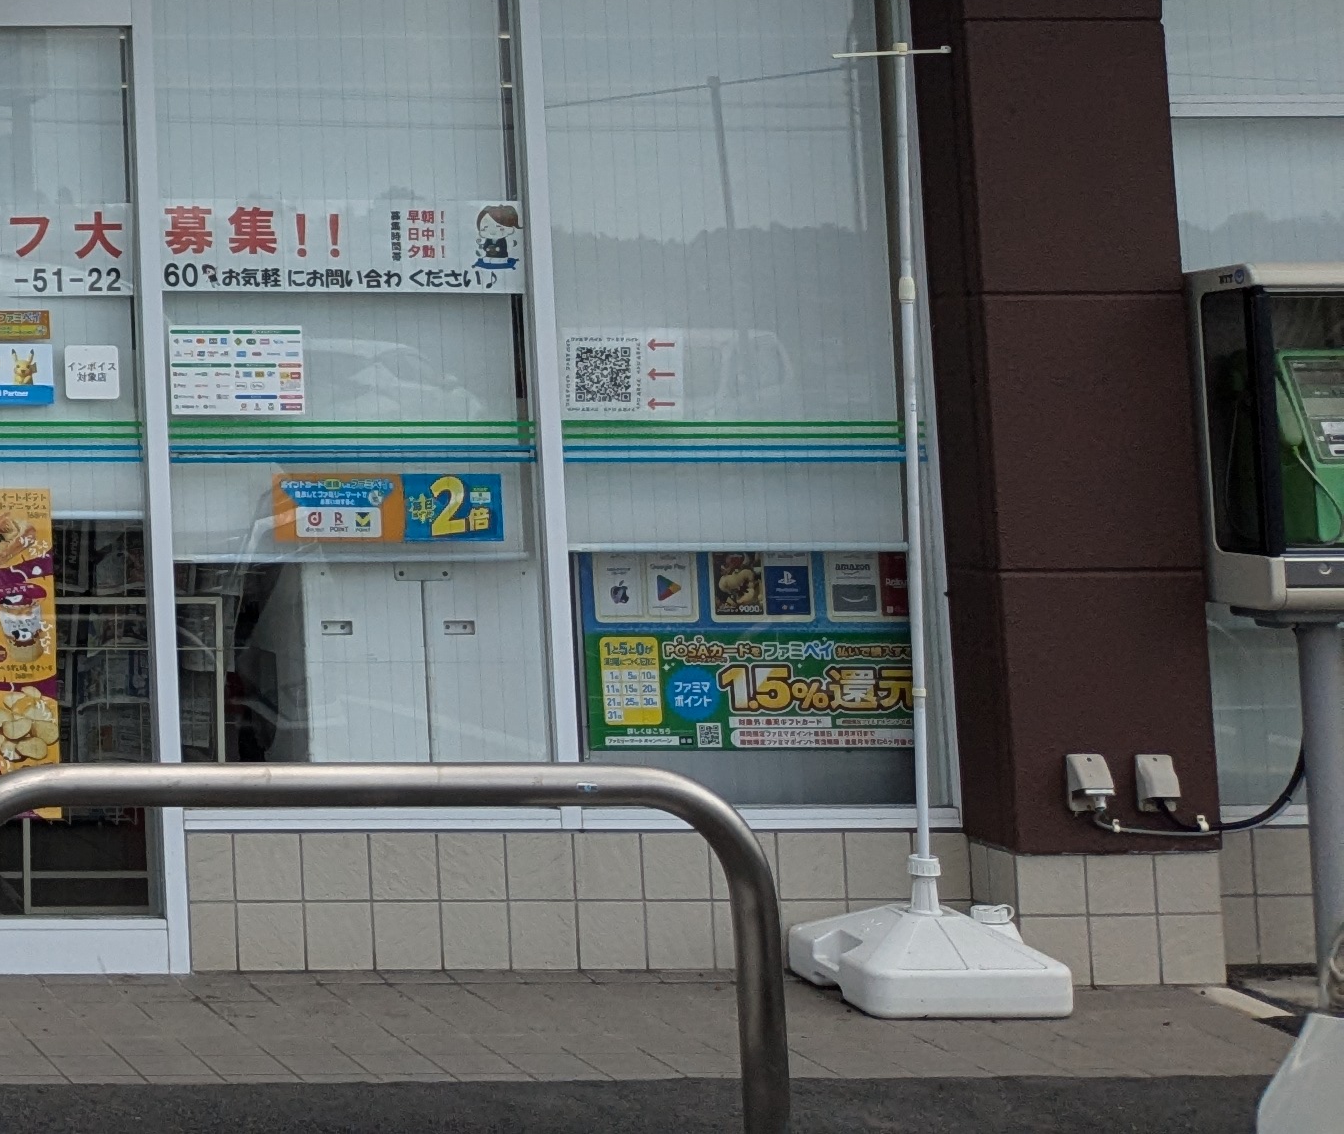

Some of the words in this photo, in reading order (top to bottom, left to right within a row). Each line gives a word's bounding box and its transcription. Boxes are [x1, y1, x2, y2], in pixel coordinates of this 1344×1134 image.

[67, 362, 117, 372] インボイス
[76, 372, 107, 383] 対象店
[673, 681, 711, 694] ファミマ
[674, 694, 712, 708] ポイント
